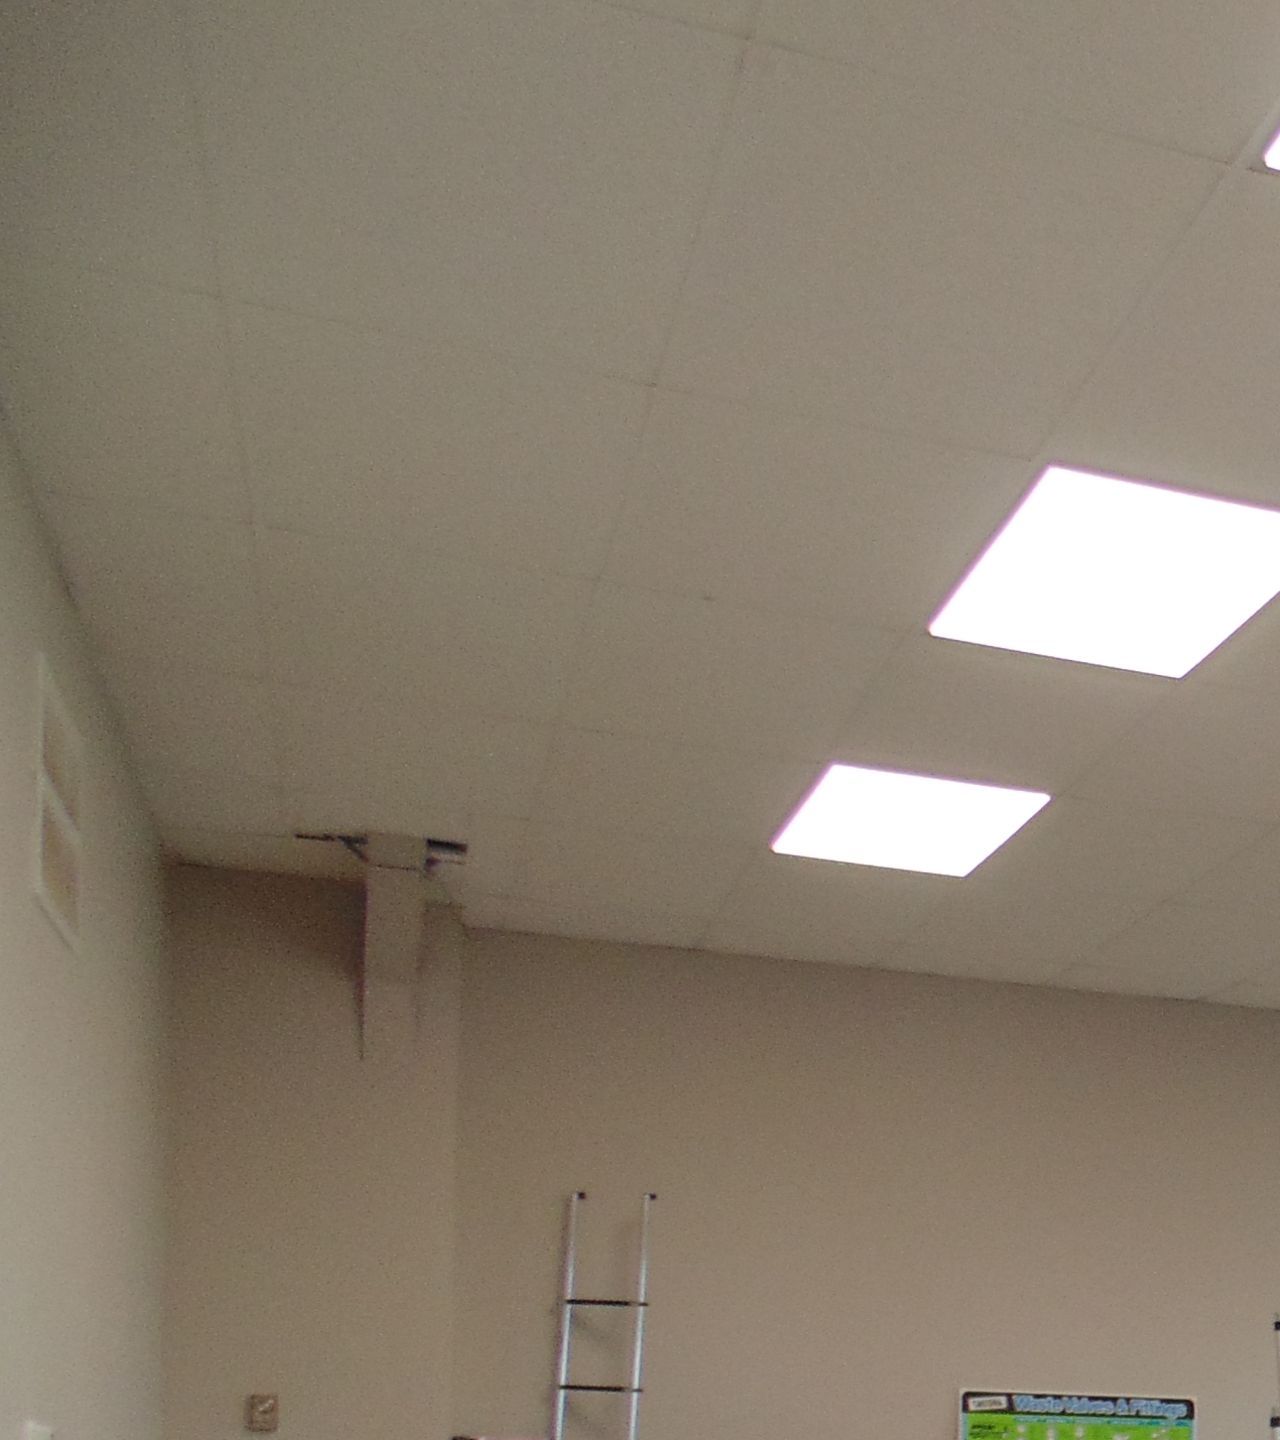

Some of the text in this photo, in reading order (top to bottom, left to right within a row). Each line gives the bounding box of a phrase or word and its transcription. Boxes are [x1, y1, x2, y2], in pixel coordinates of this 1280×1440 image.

[1013, 1395, 1061, 1414] Waste
[1062, 1397, 1114, 1415] Valves
[1130, 1399, 1188, 1420] Fittings
